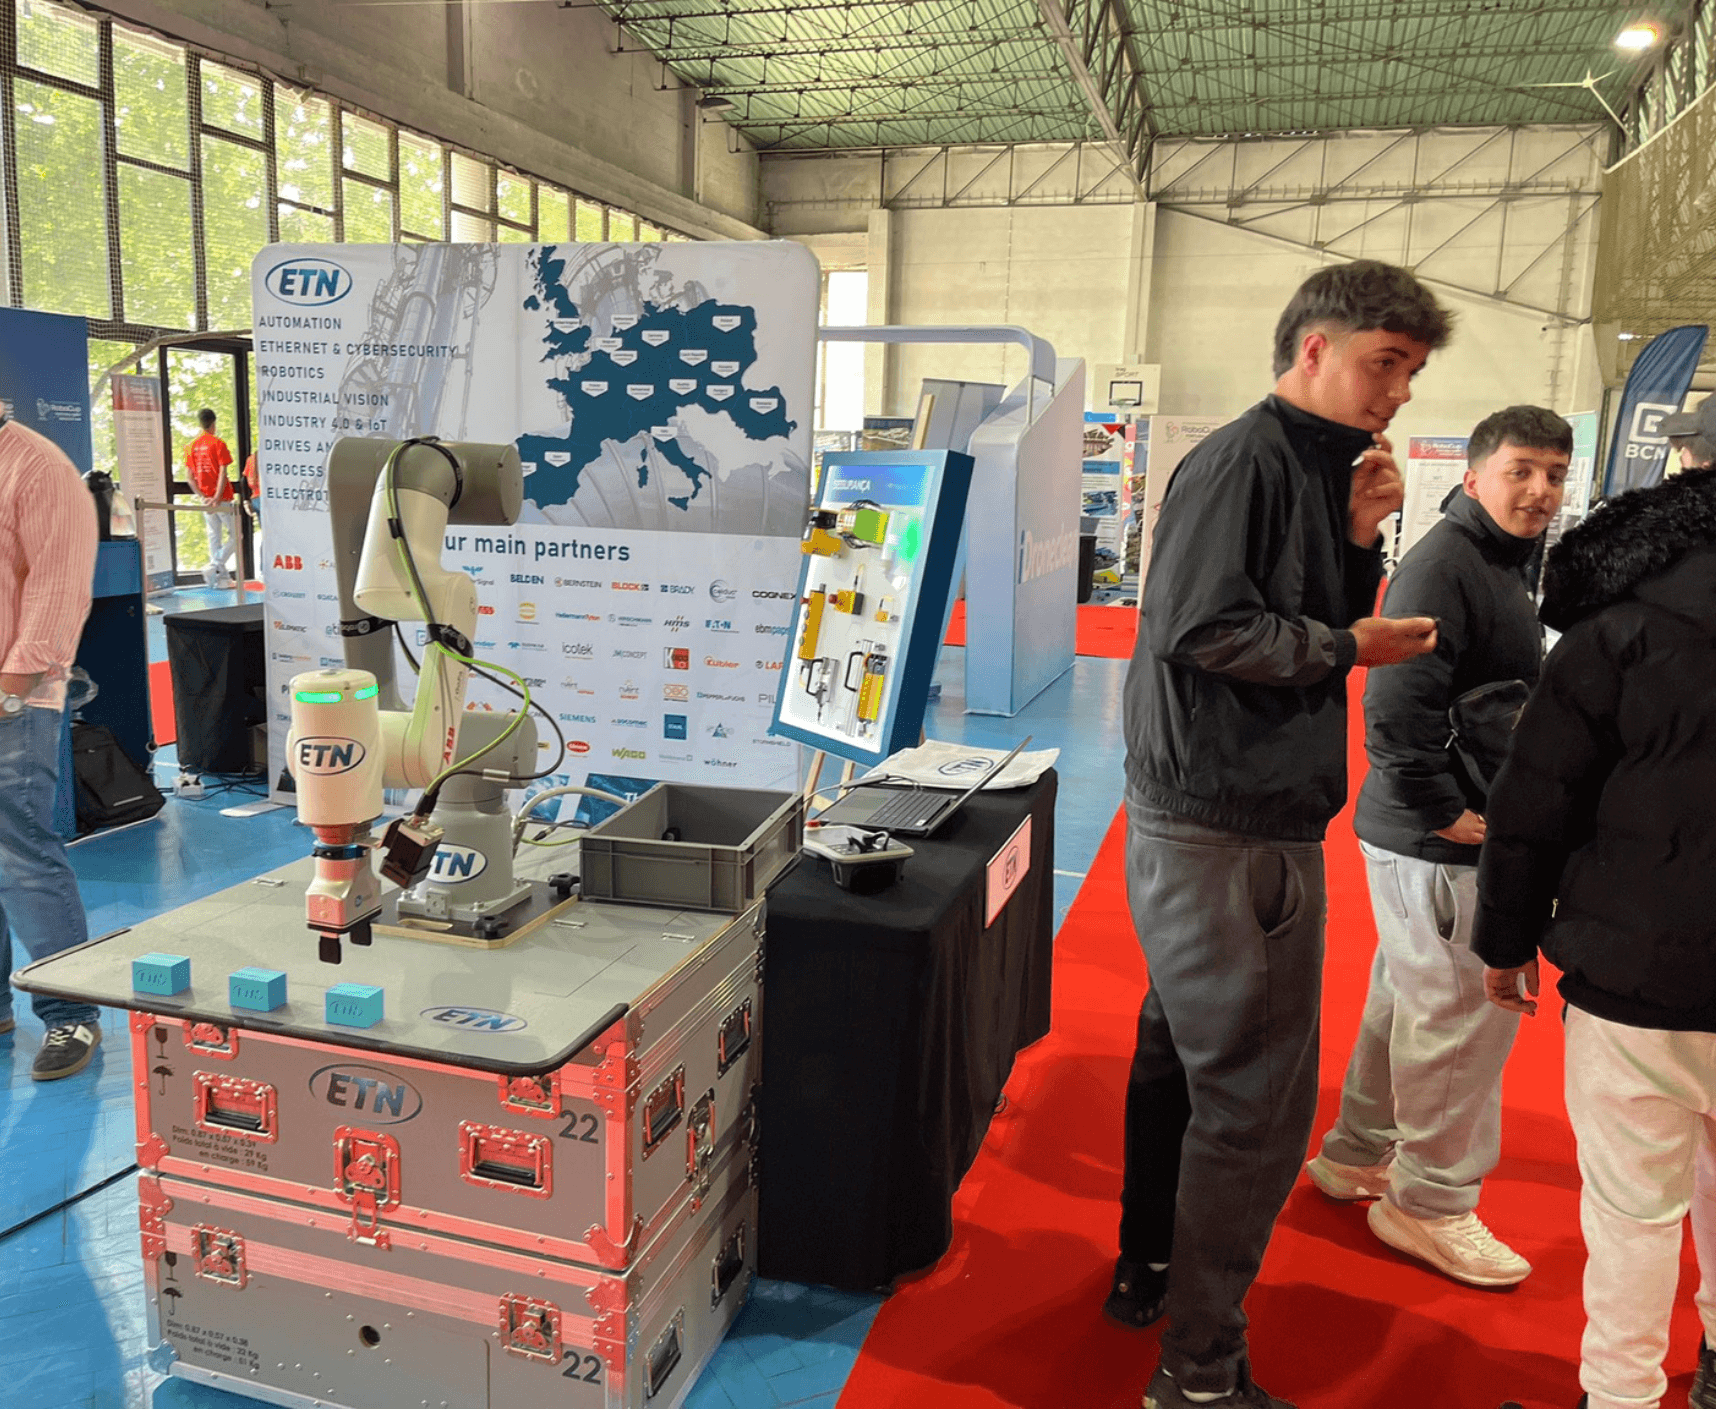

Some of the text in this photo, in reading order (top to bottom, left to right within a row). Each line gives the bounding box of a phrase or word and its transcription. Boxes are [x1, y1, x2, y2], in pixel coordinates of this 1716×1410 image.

[279, 268, 340, 297] ETN
[259, 316, 342, 331] AUTOMATION
[260, 340, 457, 358] ETHERNET & CYBERSECURITY
[261, 365, 325, 379] ROBOTICS
[262, 390, 389, 406] INDUSTRIAL VISION
[263, 415, 387, 431] INDUSTRY 4.0 & IoT
[265, 439, 333, 453] DRIVES AN
[266, 463, 324, 478] PROCESS
[266, 487, 329, 500] ELECTROT
[445, 534, 631, 562] ur main partners
[273, 554, 303, 570] ABB
[510, 574, 544, 585] BELDEN
[752, 591, 796, 600] COGNEX
[758, 694, 776, 703] PIL
[560, 713, 596, 723] SIEMENS
[301, 743, 354, 768] ETN
[435, 851, 475, 876] TN
[433, 1009, 518, 1031] ETN
[326, 1072, 405, 1117] ETN
[559, 1110, 599, 1144] 22
[211, 1153, 239, 1164] charge
[562, 1350, 601, 1385] 22
